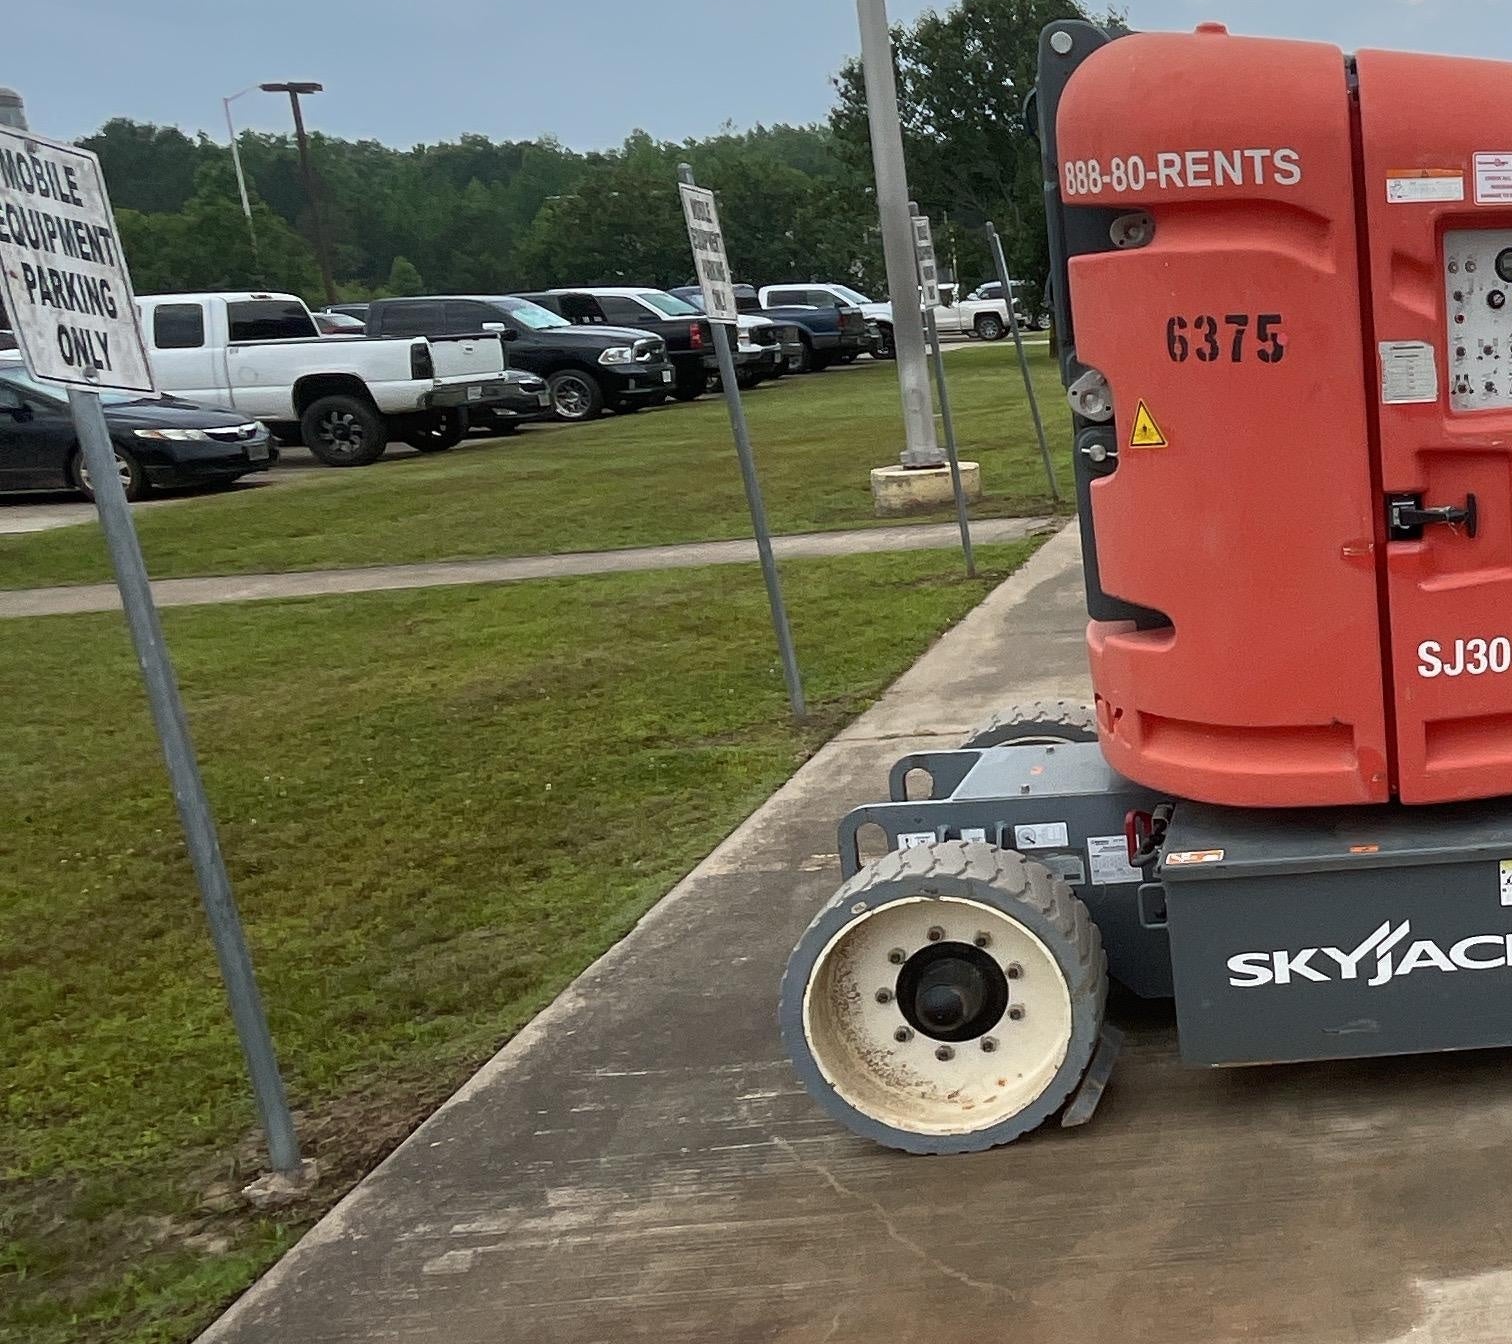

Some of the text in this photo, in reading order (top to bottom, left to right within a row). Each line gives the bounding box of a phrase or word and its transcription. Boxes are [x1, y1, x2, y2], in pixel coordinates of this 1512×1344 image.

[0, 147, 83, 207] MOBILE
[1065, 148, 1301, 195] 888-80-RENTS
[21, 262, 118, 319] PARKING
[57, 324, 112, 371] ONLY
[1166, 314, 1285, 363] 6375
[1418, 637, 1511, 678] SJ30
